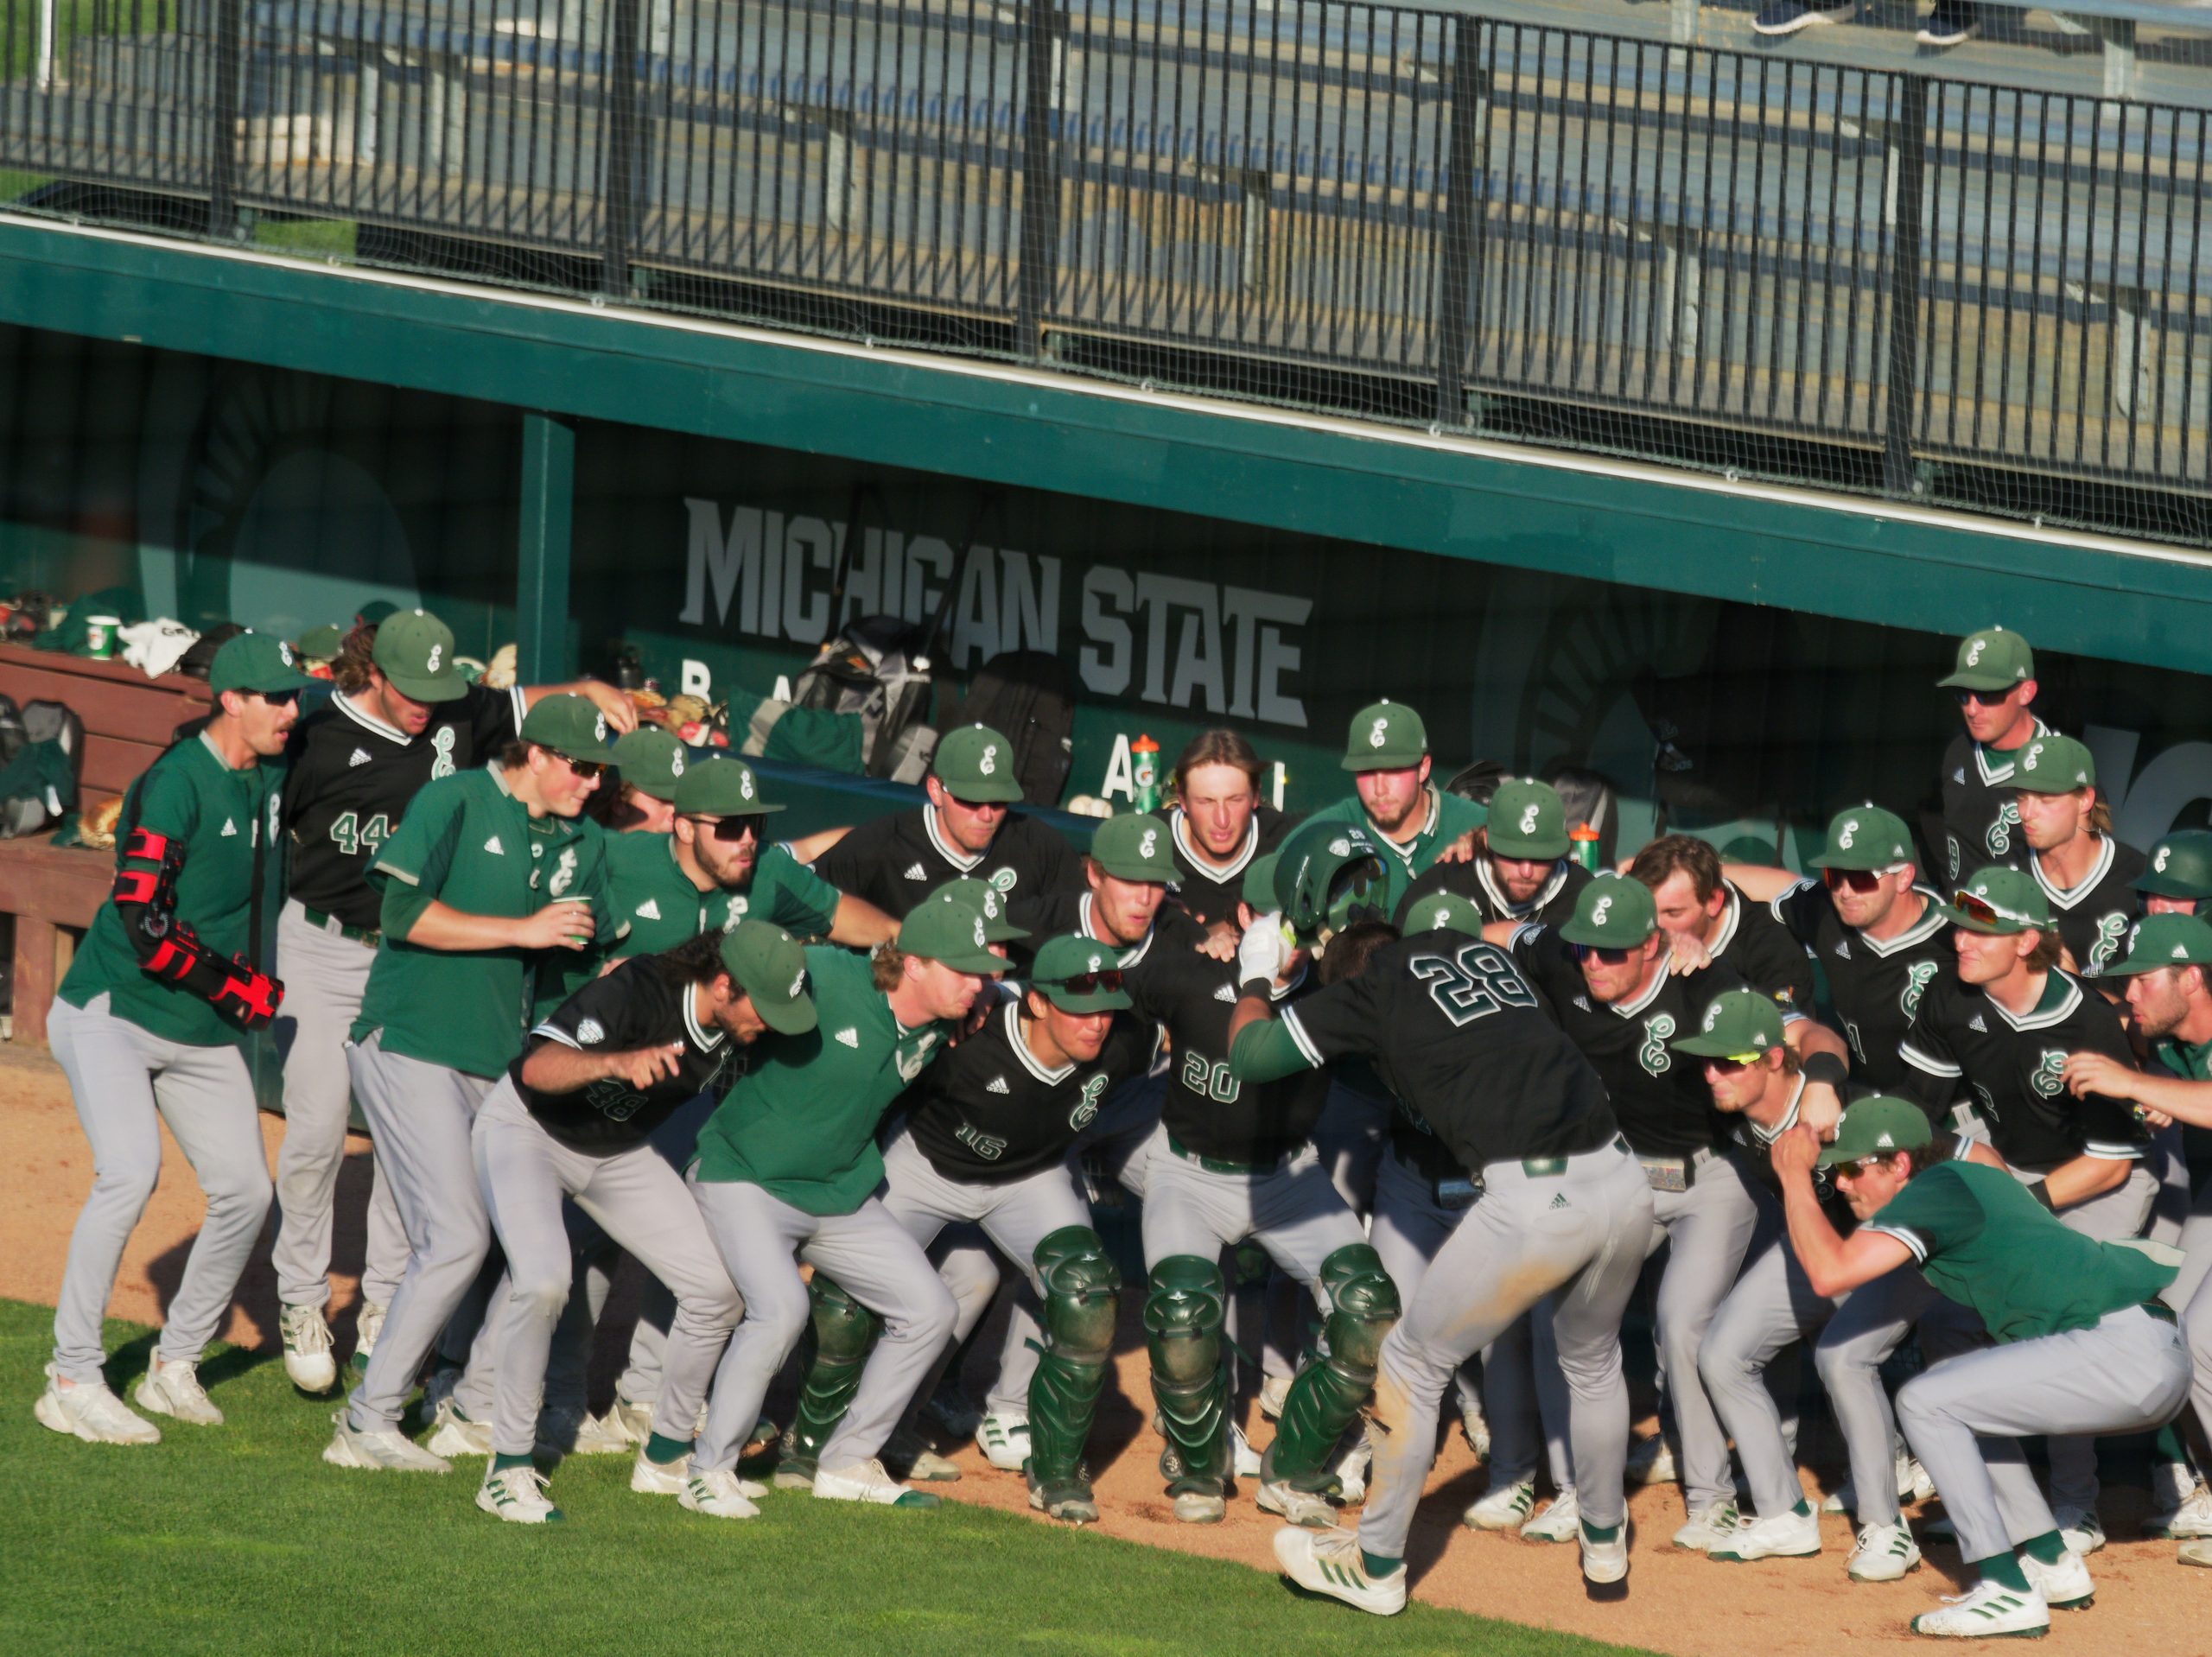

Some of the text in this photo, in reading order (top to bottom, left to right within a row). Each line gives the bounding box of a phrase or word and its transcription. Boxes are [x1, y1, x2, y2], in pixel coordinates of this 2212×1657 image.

[678, 497, 1313, 727] MICHIGAN STATE
[427, 644, 442, 673] E
[1967, 639, 1986, 668] E
[1370, 718, 1388, 749] E
[671, 747, 684, 778] E
[980, 745, 996, 776] E
[2024, 744, 2044, 771] E
[741, 771, 753, 800] E
[1134, 764, 1154, 788] G
[329, 811, 391, 855] 44
[1519, 804, 1540, 835] E
[1139, 829, 1157, 860] E
[1839, 821, 1859, 850] E
[2154, 848, 2171, 873] E
[984, 890, 998, 919] E
[1592, 896, 1612, 928] E
[974, 917, 986, 948] E
[1214, 994, 1238, 1005] adidas
[1410, 943, 1538, 1027] 28
[1703, 1004, 1722, 1033] E
[1968, 1023, 1988, 1033] adidas
[1640, 1013, 1676, 1078] E
[986, 1085, 1010, 1095] adidas
[1182, 1051, 1241, 1104] 20
[2031, 1051, 2069, 1100] E
[1070, 1075, 1109, 1133] E
[955, 1123, 1007, 1160] 16
